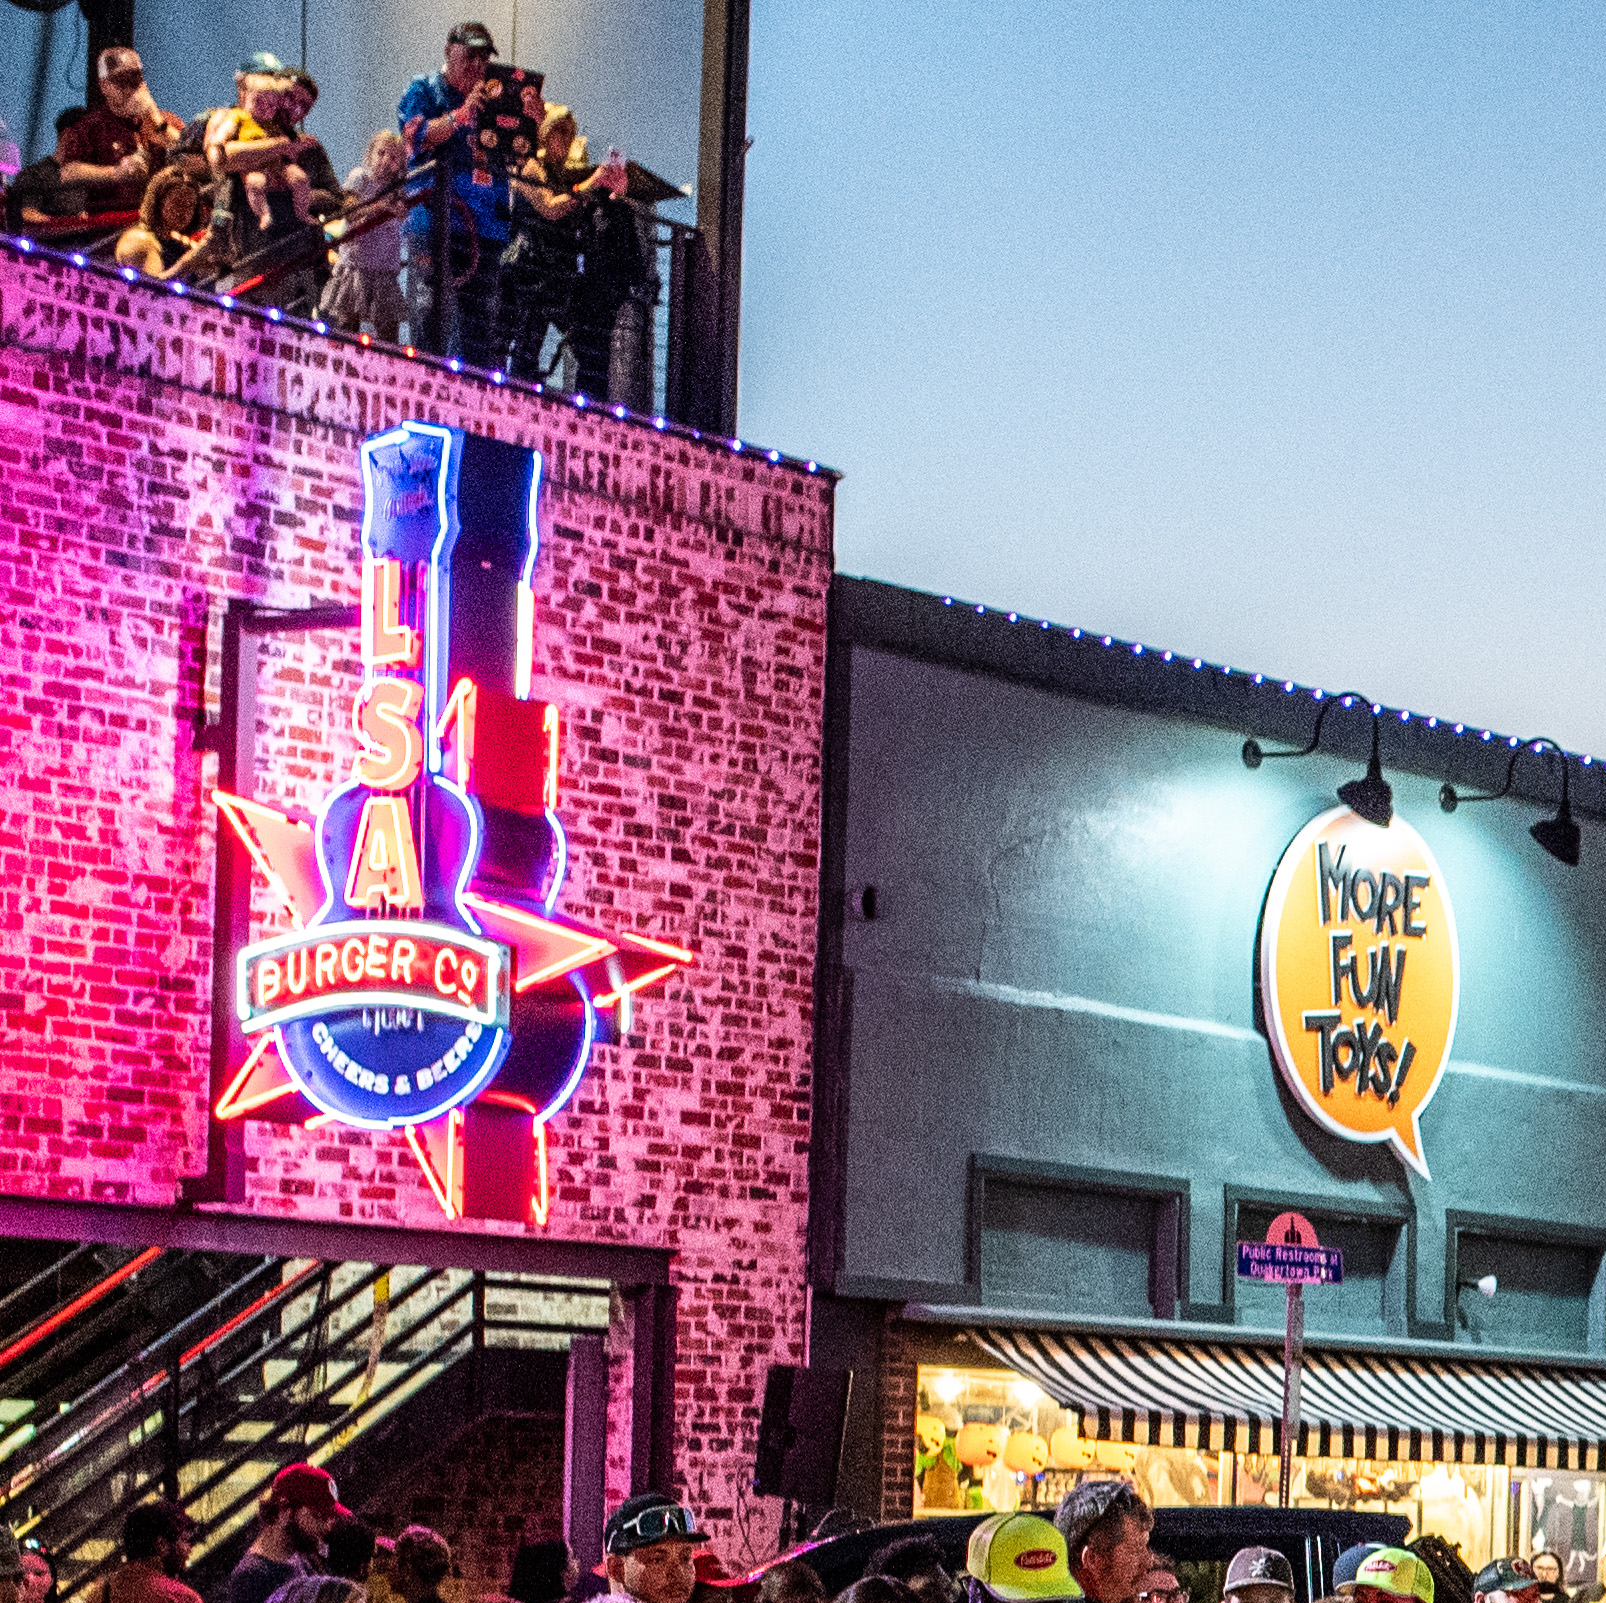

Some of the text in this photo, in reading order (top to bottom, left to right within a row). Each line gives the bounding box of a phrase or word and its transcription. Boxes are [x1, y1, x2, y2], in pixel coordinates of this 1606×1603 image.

[1314, 838, 1430, 940] MORE
[257, 935, 415, 1006] BURGER
[1329, 929, 1407, 1026] FUN
[311, 1021, 483, 1095] CHEERS & BEERS
[1301, 1009, 1417, 1111] TOYS!
[1242, 1244, 1272, 1260] Public
[1275, 1248, 1327, 1265] Restrooms
[1250, 1261, 1333, 1281] Quakertown Prk
